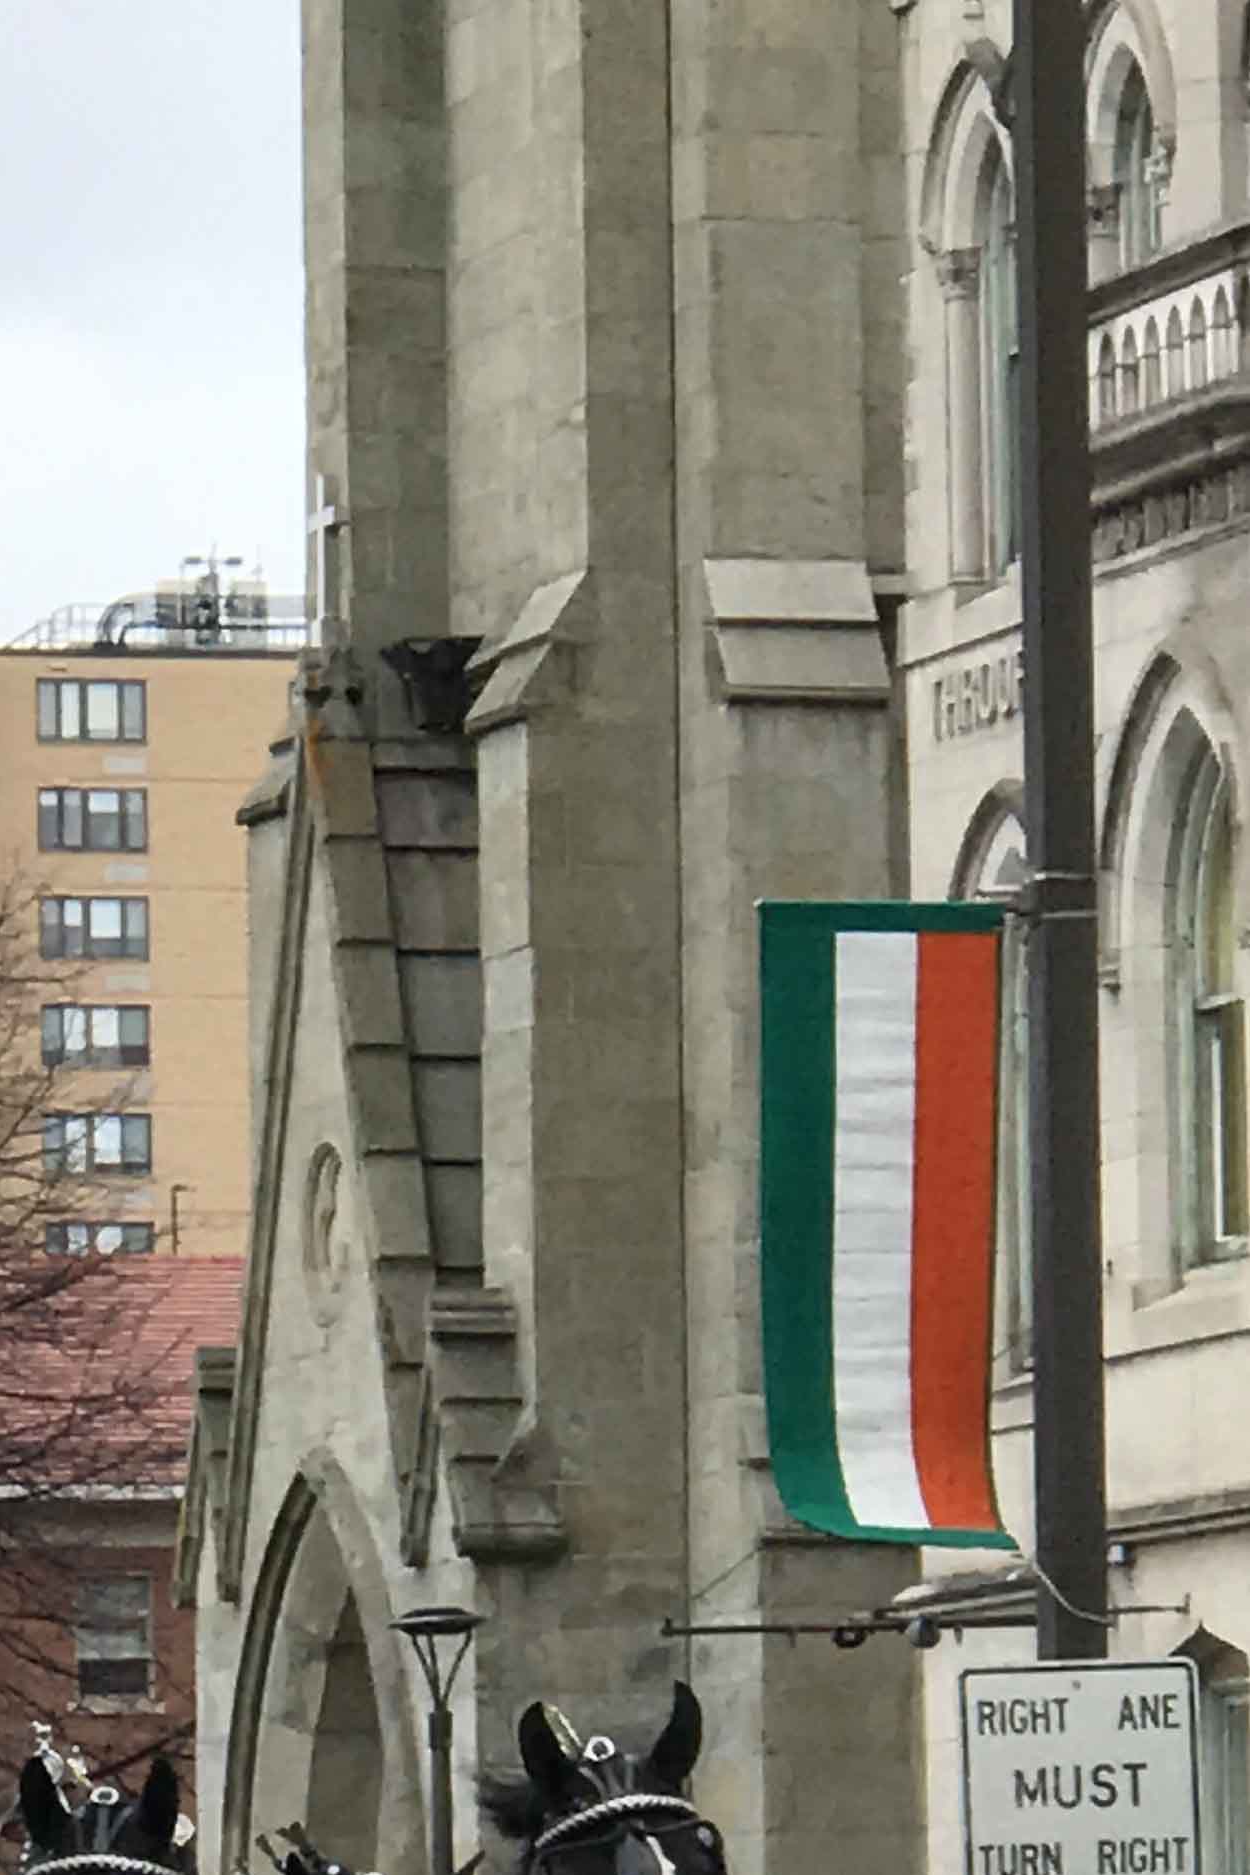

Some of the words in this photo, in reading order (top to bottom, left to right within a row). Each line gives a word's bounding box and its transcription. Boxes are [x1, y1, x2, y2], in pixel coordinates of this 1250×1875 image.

[977, 1697, 1069, 1736] RIGHT
[1013, 1763, 1148, 1809] MUST
[1097, 1836, 1189, 1875] RIGHT
